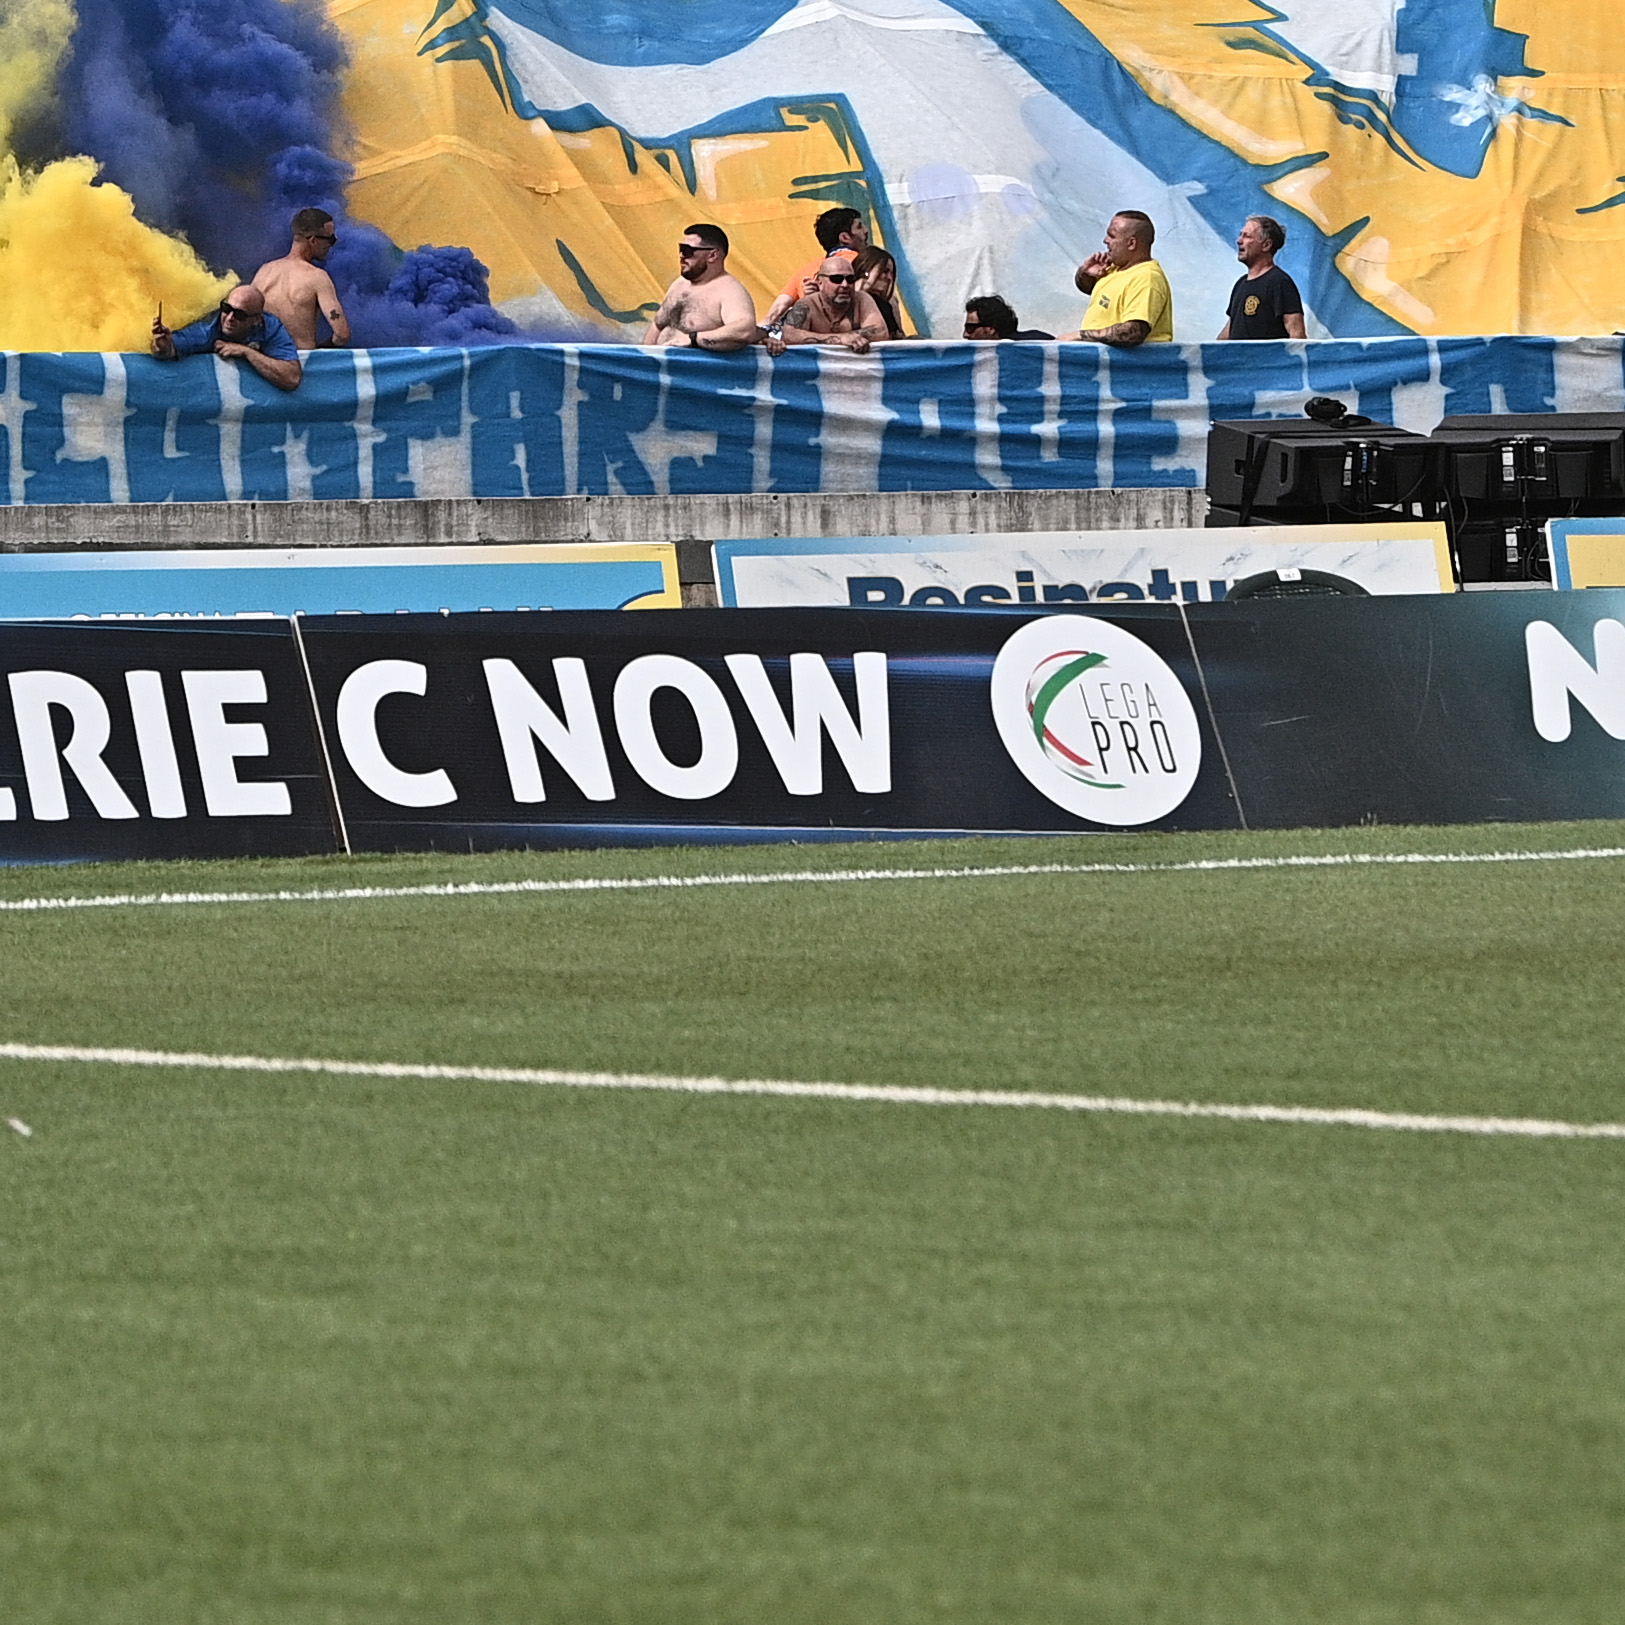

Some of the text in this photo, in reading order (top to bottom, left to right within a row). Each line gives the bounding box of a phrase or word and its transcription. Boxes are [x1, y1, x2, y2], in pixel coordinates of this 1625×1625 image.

[1079, 682, 1163, 720] LEGA
[336, 658, 458, 808] C
[483, 652, 892, 803] NOW
[1090, 720, 1177, 775] PRO
